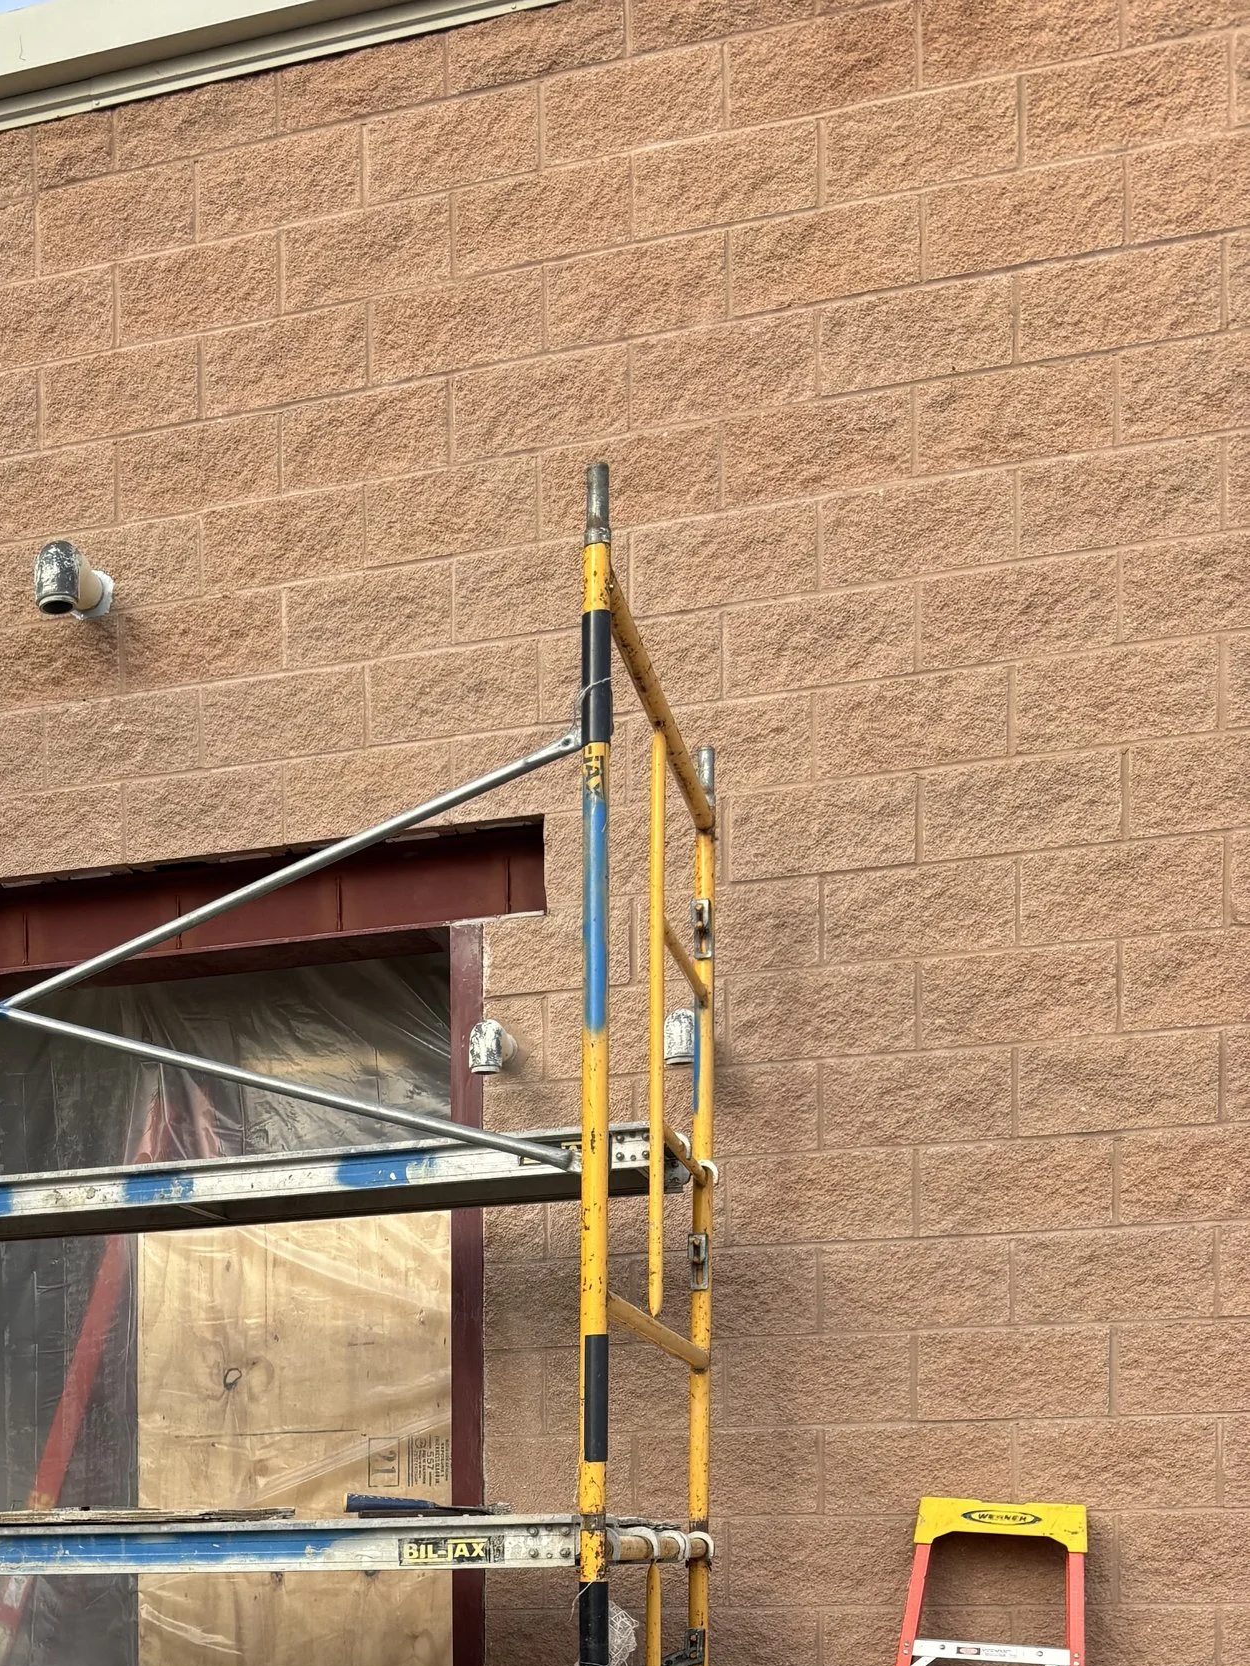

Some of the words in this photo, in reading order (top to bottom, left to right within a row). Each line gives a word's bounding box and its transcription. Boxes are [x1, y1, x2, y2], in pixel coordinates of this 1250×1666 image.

[426, 1451, 435, 1471] 557
[978, 1513, 1027, 1522] WERNER
[403, 1538, 488, 1562] BIL-JAX
